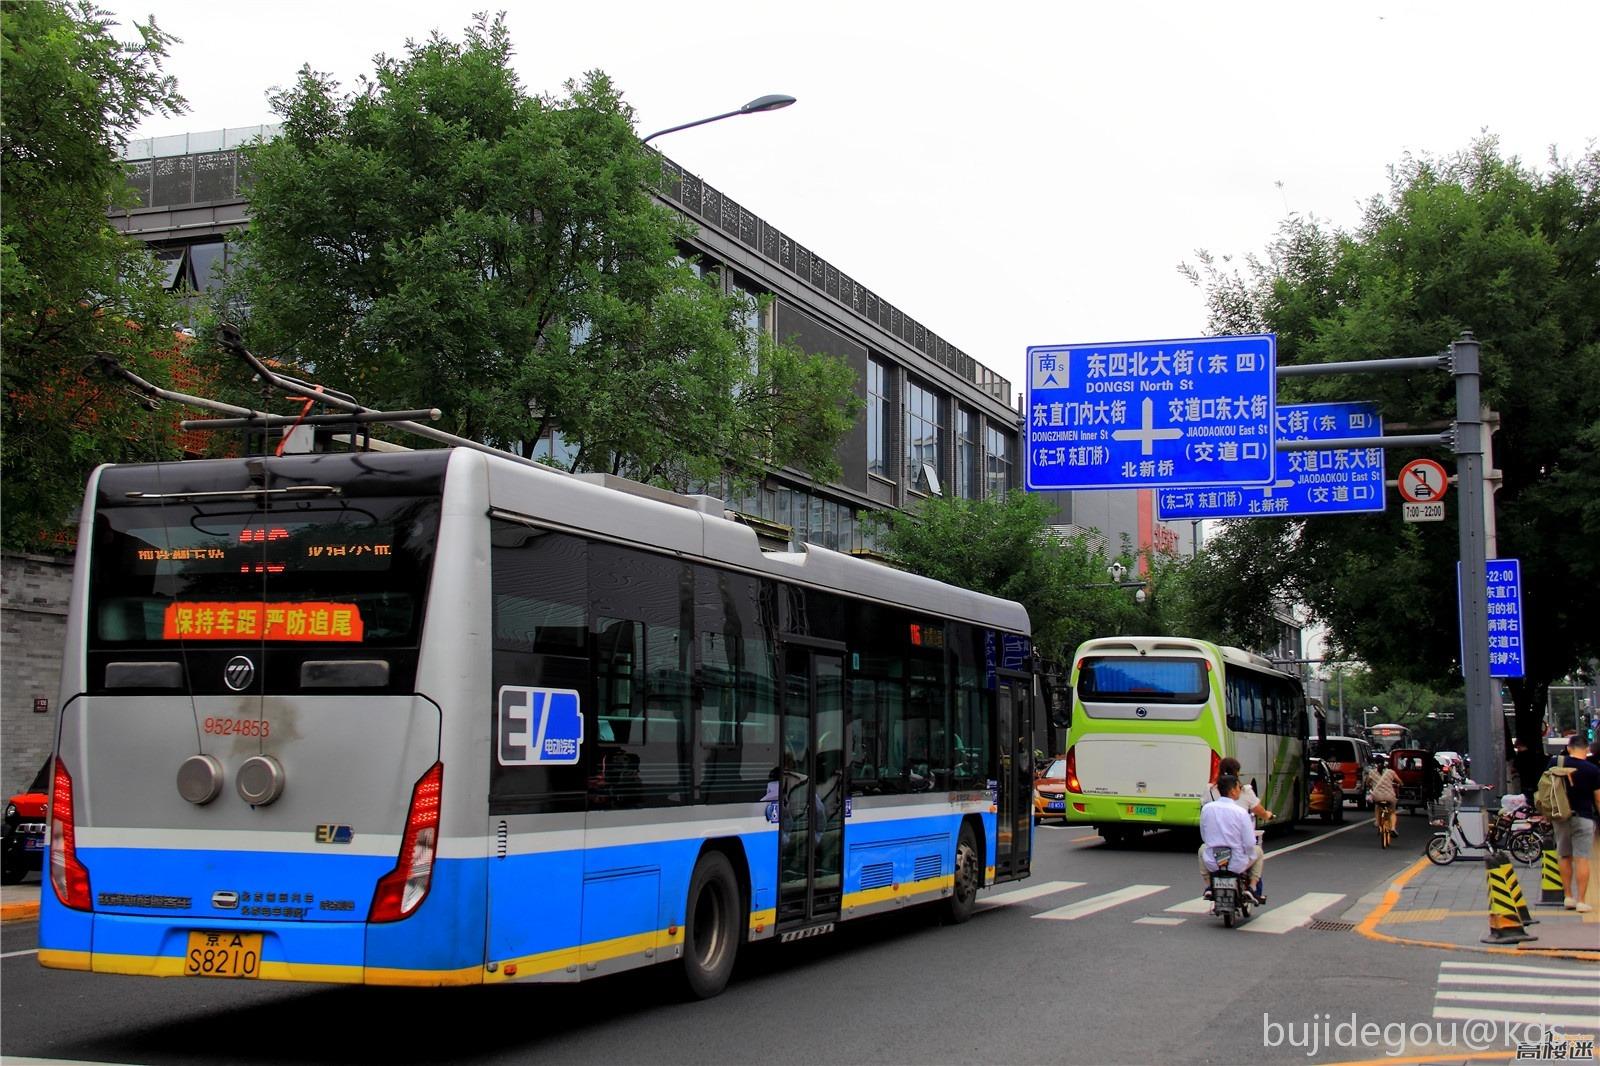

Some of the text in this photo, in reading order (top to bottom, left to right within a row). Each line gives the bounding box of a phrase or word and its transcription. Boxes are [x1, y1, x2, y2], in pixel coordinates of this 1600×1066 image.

[1039, 353, 1056, 372] 南
[1085, 379, 1194, 393] DONGSI North St
[1032, 399, 1127, 427] 东直门内大街
[1168, 394, 1268, 423] 交道口东大街
[1032, 429, 1109, 442] DONGZHIMEN Inner St
[1186, 424, 1268, 438] JIAODAOKOU East St
[1185, 441, 1268, 462] (交道口)
[1287, 447, 1381, 473] 交道口东大街
[1121, 459, 1175, 478] 北新桥
[1298, 470, 1380, 485] JIAODAOKOU East St
[1307, 485, 1375, 503] (交道口)
[1248, 497, 1289, 513] 北新桥
[1405, 505, 1442, 518] 7:00-22:00
[174, 608, 353, 637] 保持车距 严防追尾
[1488, 635, 1520, 649] 交道口
[204, 717, 270, 738] 9524853
[189, 948, 257, 974] S8210
